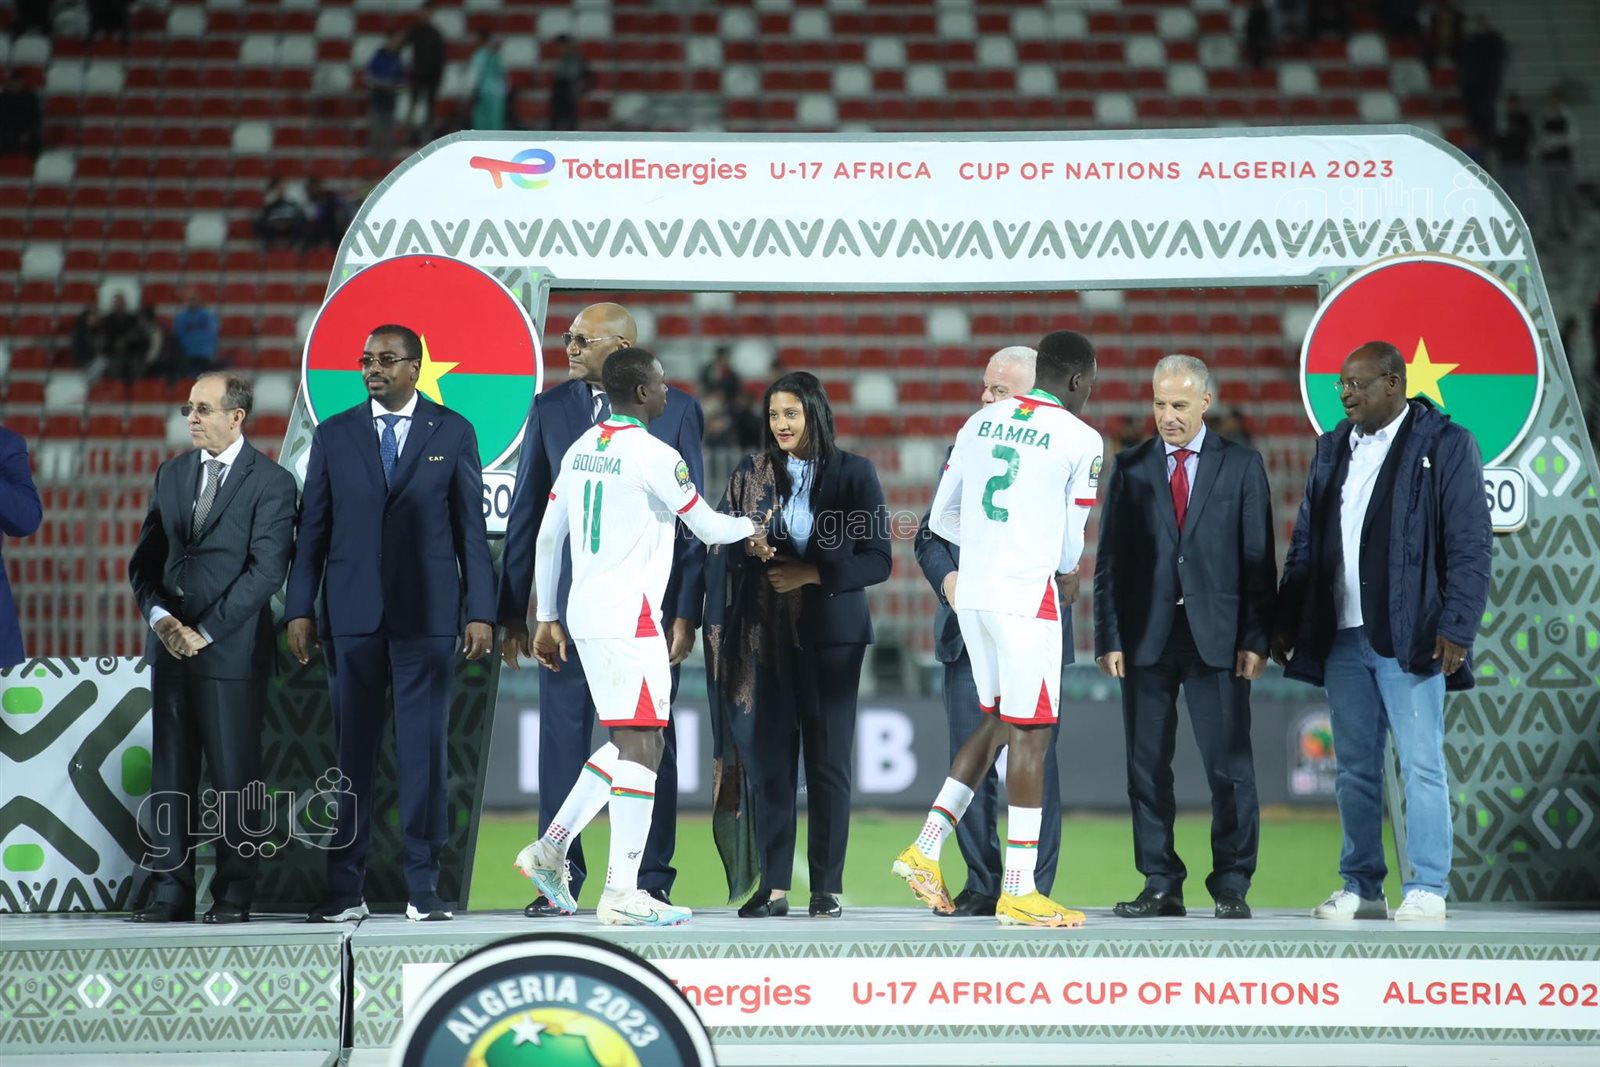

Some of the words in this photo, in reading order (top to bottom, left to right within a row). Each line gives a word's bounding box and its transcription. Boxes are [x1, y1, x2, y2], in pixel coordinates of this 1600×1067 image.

[562, 157, 747, 185] TotalEnergies
[769, 161, 823, 180] U-17
[833, 161, 931, 180] AFRICA
[958, 162, 1010, 181] CUP
[1020, 162, 1055, 181] OF
[1065, 161, 1181, 181] NATIONS
[1198, 161, 1317, 180] ALGERIA
[1327, 160, 1394, 179] 2023
[977, 421, 1051, 450] BAMBA
[572, 453, 622, 476] BOUGMA
[981, 444, 1021, 523] 2
[582, 479, 604, 555] 11
[445, 974, 579, 1046] ALGERIA
[591, 987, 661, 1049] 2023
[671, 976, 813, 1014] nergies
[851, 981, 918, 1006] U-17
[928, 981, 1052, 1006] AFRICA
[1062, 981, 1128, 1006] CUP
[1137, 981, 1184, 1006] OF
[1194, 981, 1340, 1007] NATIONS
[1382, 981, 1528, 1007] ALGERIA
